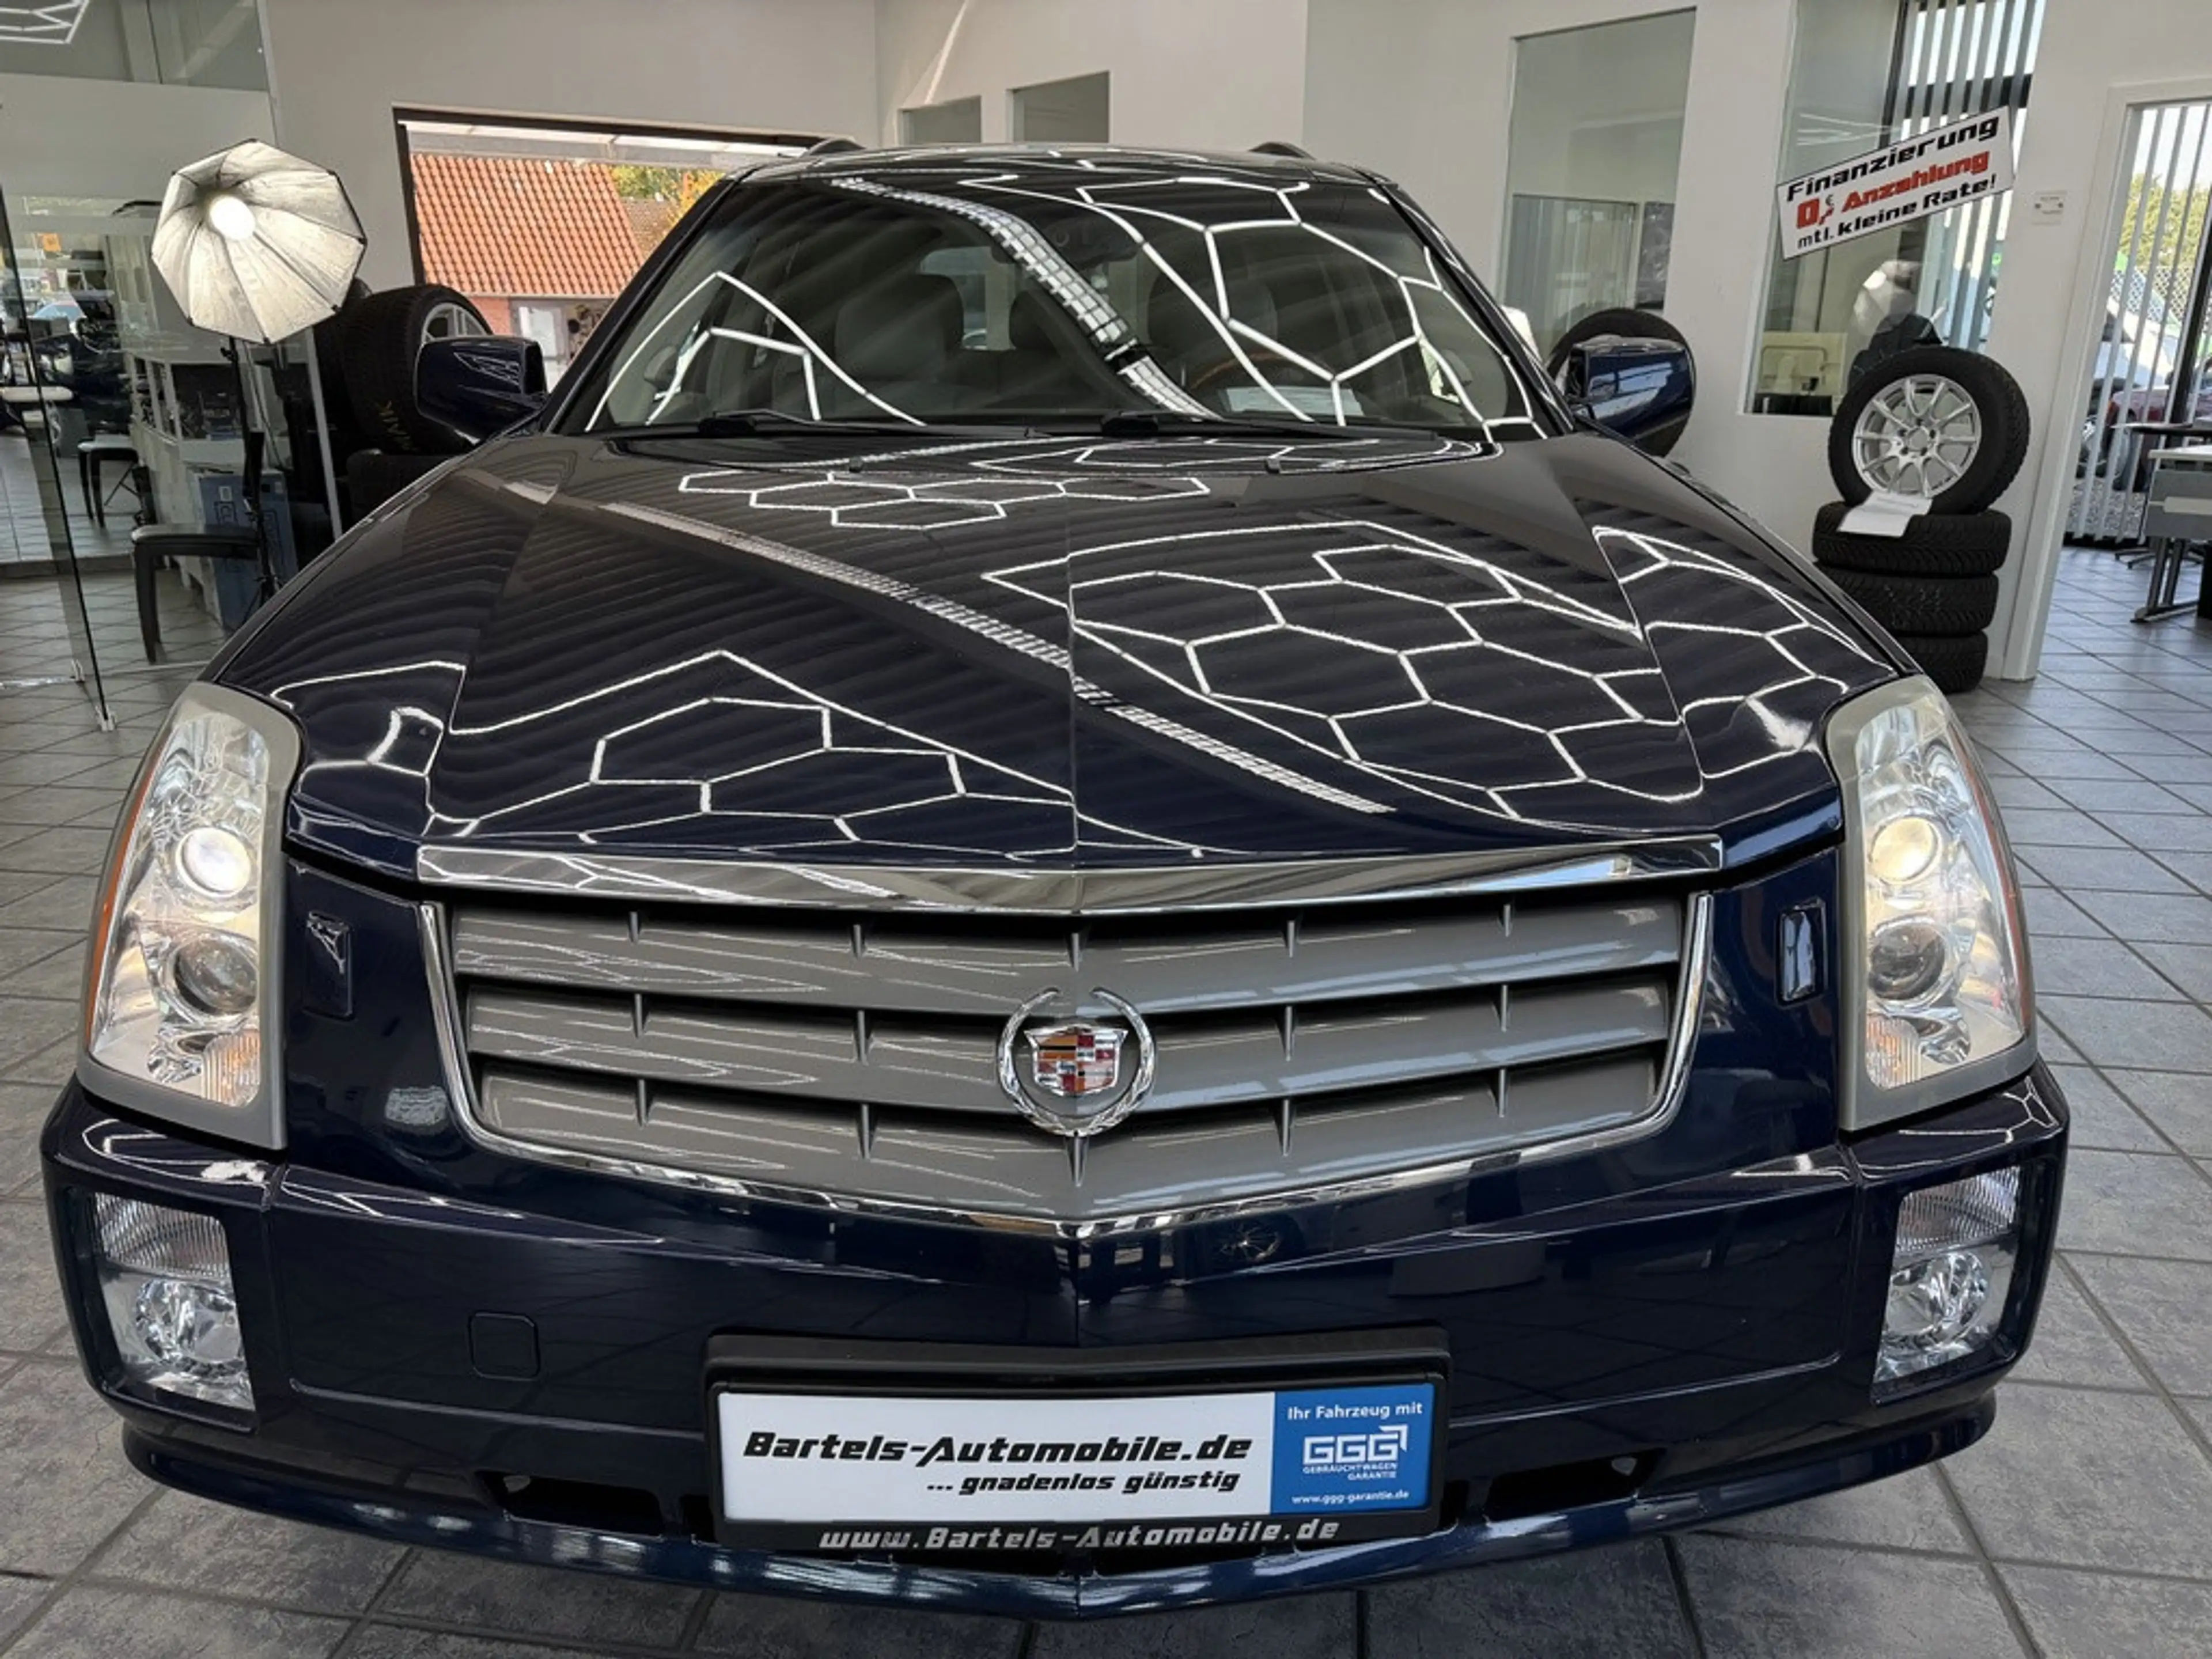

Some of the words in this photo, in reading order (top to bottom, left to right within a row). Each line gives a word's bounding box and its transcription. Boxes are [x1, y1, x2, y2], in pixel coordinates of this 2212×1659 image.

[1786, 116, 1999, 202] Finanzierung
[1841, 150, 1990, 213] Anzahlung
[1797, 226, 1835, 249] mtl.
[1838, 200, 1917, 237] kleine
[1923, 174, 1997, 211] Rate!
[1287, 1406, 1310, 1421] Ihr
[1315, 1404, 1390, 1420] Fahrzeug
[1395, 1402, 1423, 1416] mit
[743, 1431, 1252, 1467] Bartels-Automobile.de
[1303, 1432, 1400, 1465] GGG
[1122, 1471, 1241, 1494] günstig
[1302, 1462, 1397, 1475] GEBRAUCHTWAGEN
[1347, 1471, 1397, 1481] GARANTIE
[819, 1517, 1340, 1550] www.Bartels-Automobile.de
